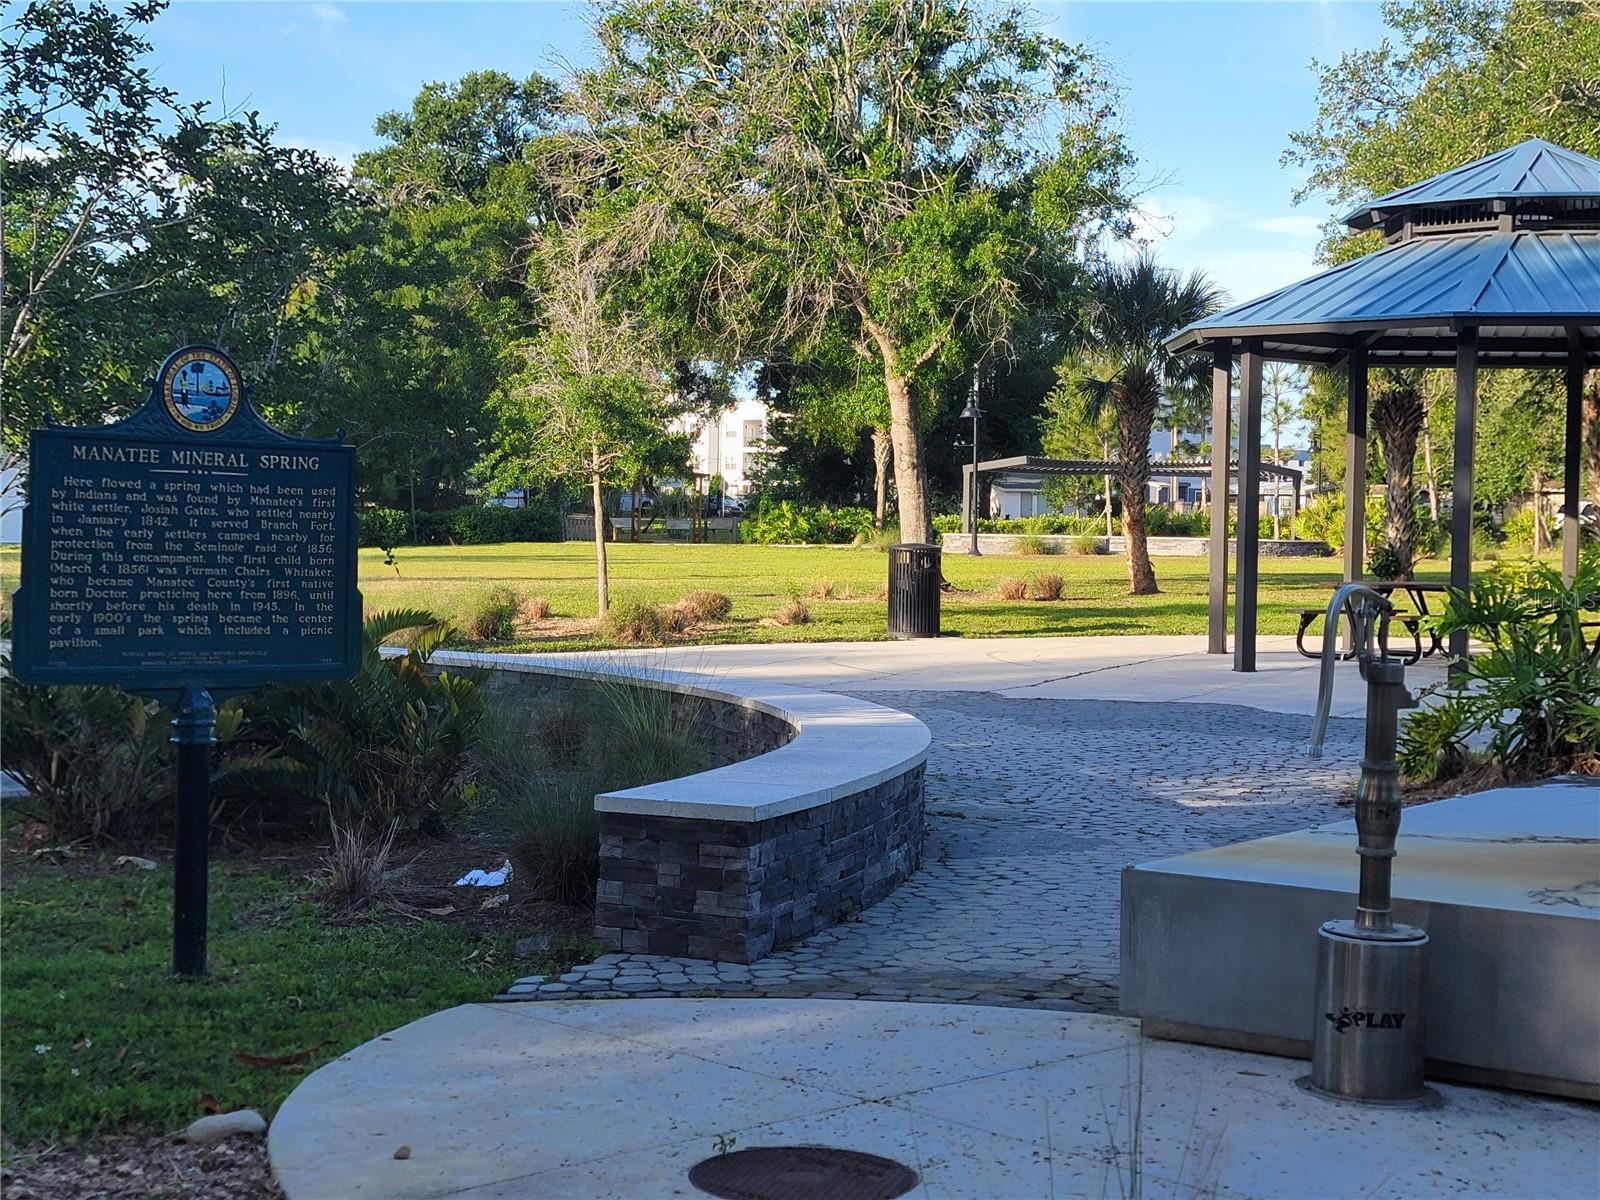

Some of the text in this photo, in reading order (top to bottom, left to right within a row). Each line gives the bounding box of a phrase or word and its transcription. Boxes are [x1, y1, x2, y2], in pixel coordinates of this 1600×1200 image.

[73, 445, 320, 470] MANATEE MINERAL SPRING
[64, 476, 336, 496] Here flowed a spring which had been used
[52, 488, 335, 508] by Indians and was found by Manatee's first
[52, 501, 85, 511] white
[141, 504, 178, 515] Josiah
[227, 508, 249, 517] who
[256, 508, 292, 518] settled
[299, 510, 335, 521] nearby
[52, 513, 64, 523] in
[78, 515, 127, 527] January
[141, 516, 172, 526] 1842.
[189, 518, 198, 527] It
[210, 520, 248, 529] served
[261, 520, 298, 530] Branch
[52, 527, 335, 543] when the early settlers camped nearby for
[51, 539, 335, 554] protection from the Seminole raid of 1856.
[51, 551, 92, 563] During
[102, 552, 123, 561] this
[217, 554, 234, 564] the
[244, 555, 266, 564] first
[275, 555, 301, 565] child
[310, 556, 334, 565] born
[50, 563, 92, 574] (March
[118, 564, 148, 574] 1856)
[157, 567, 177, 575] was
[186, 566, 227, 576] Furman
[235, 566, 271, 576] Chairs
[50, 576, 334, 589] who became Manatee County's first native
[50, 588, 78, 598] born
[140, 589, 199, 601] practicing
[207, 590, 232, 599] here
[240, 590, 266, 599] from
[310, 591, 334, 600] until
[50, 601, 334, 612] shortly before his death in 1945. In the
[50, 613, 333, 625] early 1900's the spring became the center
[49, 626, 63, 635] of
[95, 626, 125, 636] small
[138, 625, 164, 637] park
[177, 625, 211, 635] which
[224, 625, 271, 635] included
[283, 627, 288, 635] a
[301, 625, 333, 637] picnic
[49, 637, 102, 649] pavilion.
